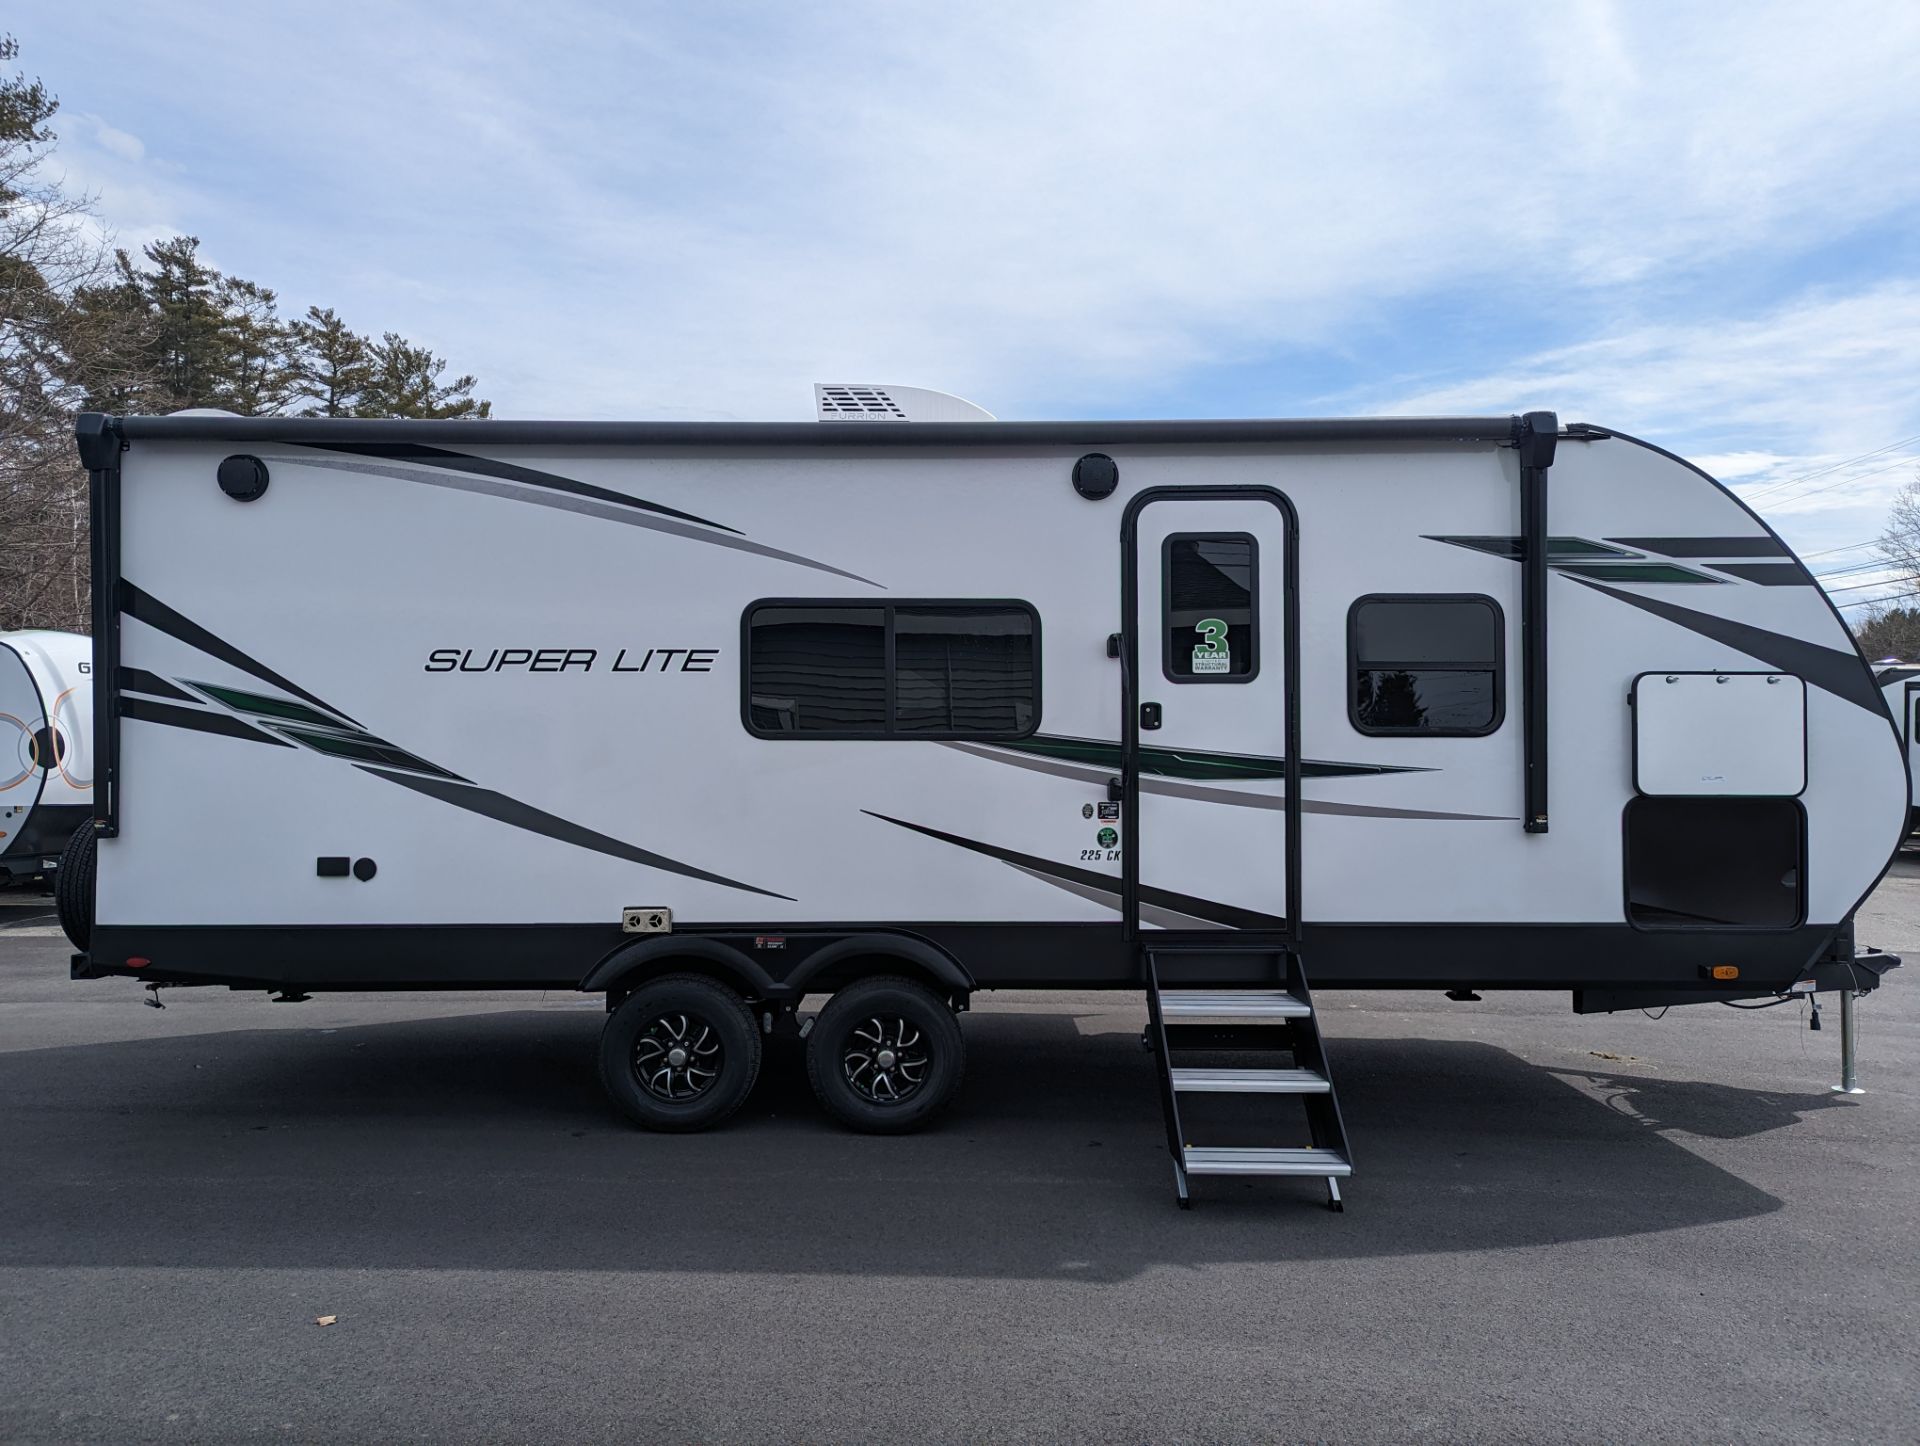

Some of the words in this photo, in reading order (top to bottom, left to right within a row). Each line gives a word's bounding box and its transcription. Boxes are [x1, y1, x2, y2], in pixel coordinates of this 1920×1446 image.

[1195, 618, 1228, 652] 3
[424, 649, 597, 672] SUPER
[611, 649, 720, 672] LITE
[1196, 651, 1227, 659] YEAR
[1080, 849, 1102, 861] 225
[1106, 850, 1121, 862] CK
